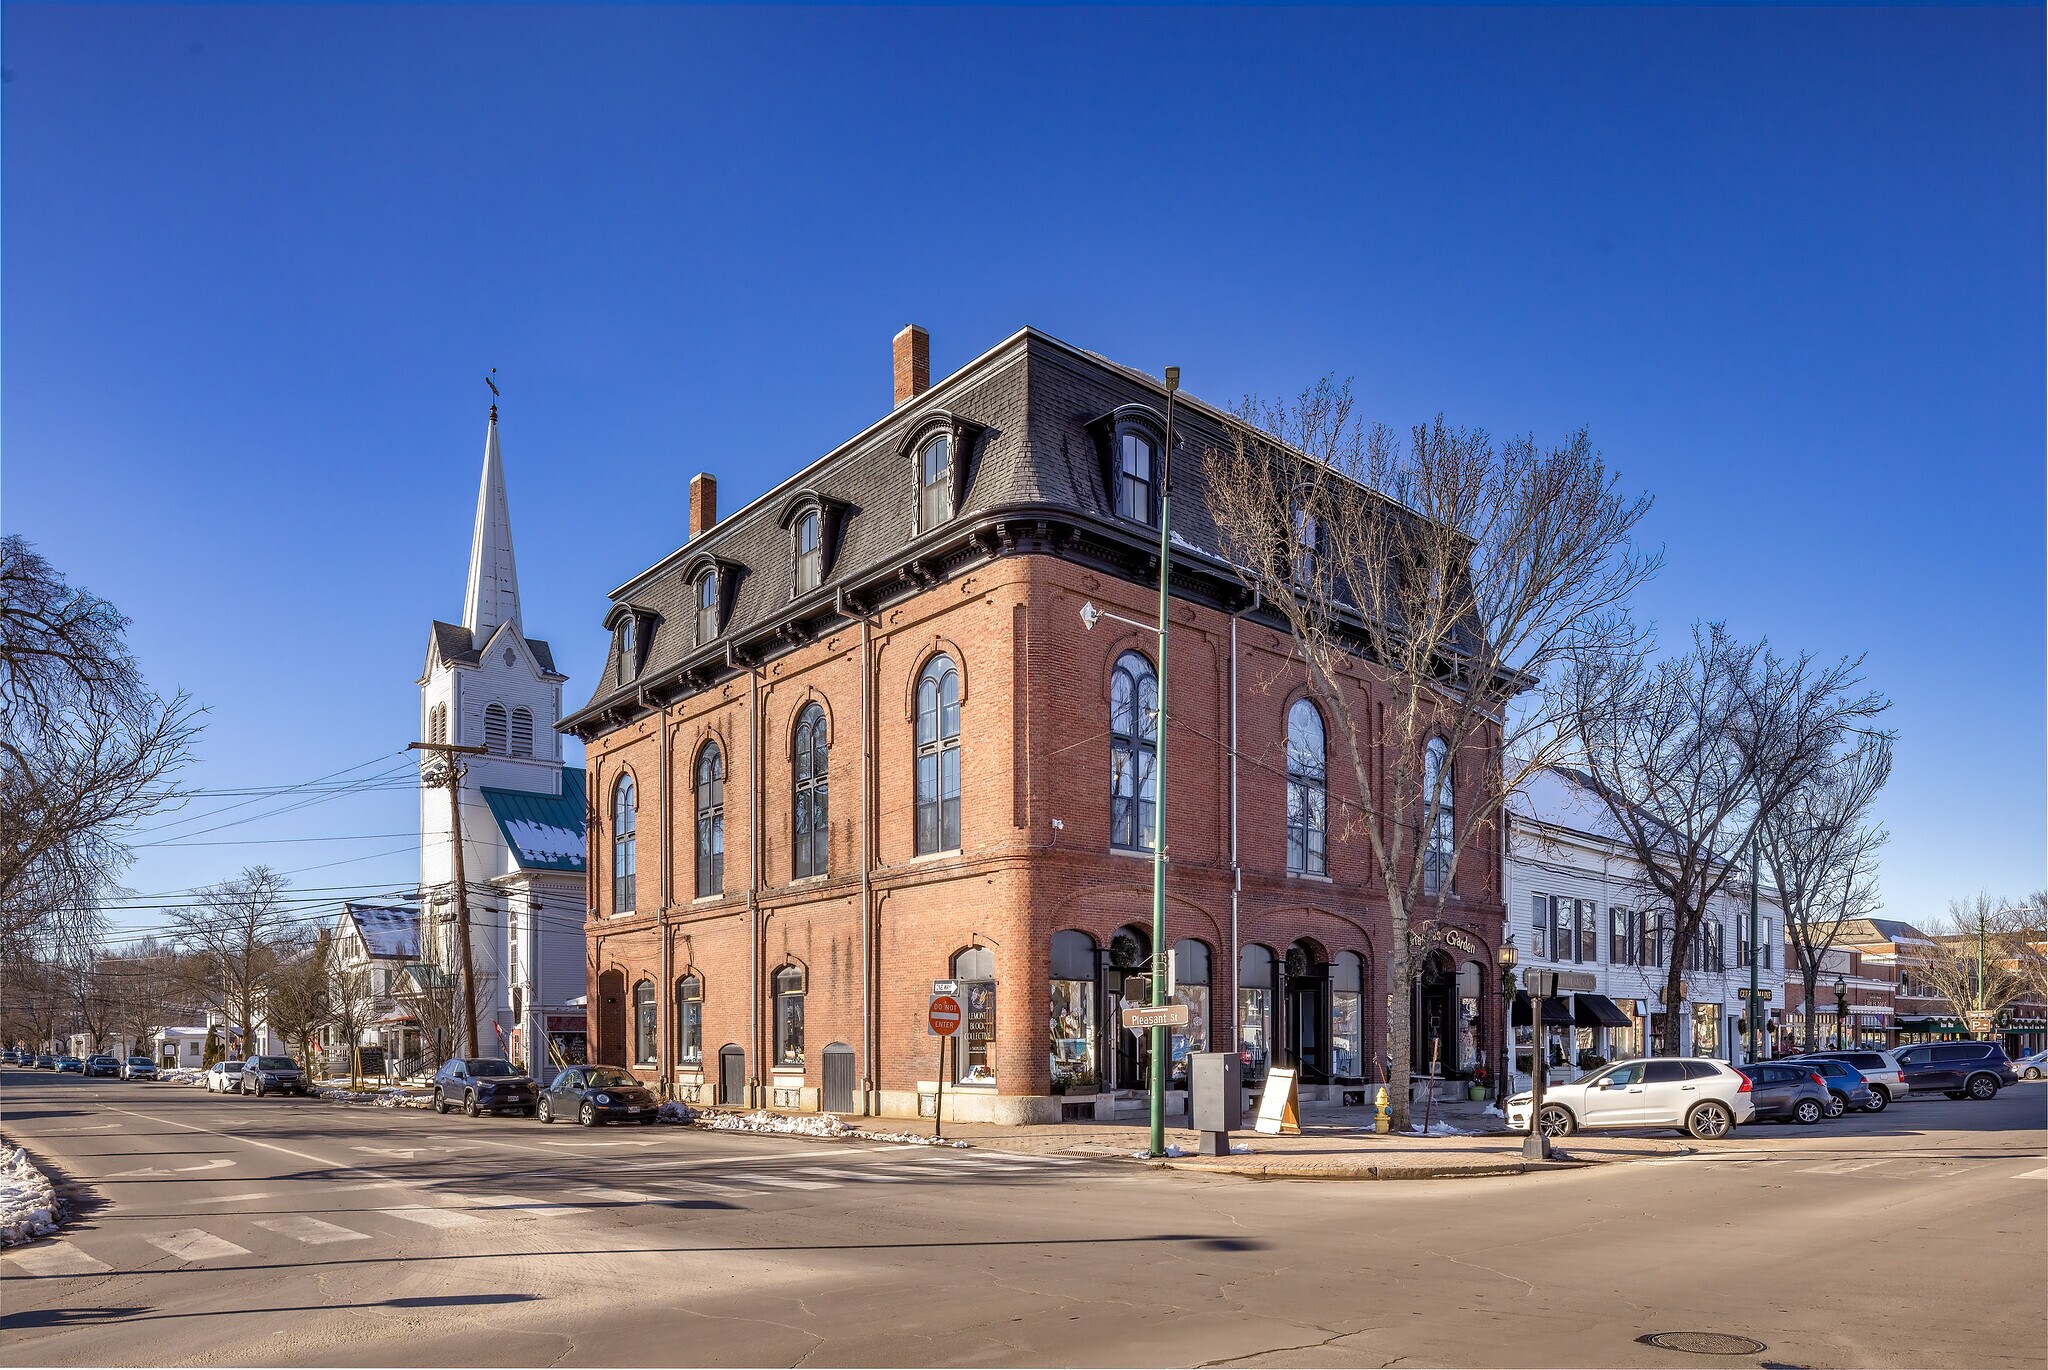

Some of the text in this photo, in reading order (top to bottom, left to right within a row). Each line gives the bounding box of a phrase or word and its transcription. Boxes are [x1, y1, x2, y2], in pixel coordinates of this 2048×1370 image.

[1446, 930, 1476, 954] Garden
[968, 1012, 986, 1020] LEMONT
[1131, 1013, 1178, 1025] Pleasant St
[935, 1021, 954, 1029] ENTER
[969, 1022, 986, 1030] BLOCK
